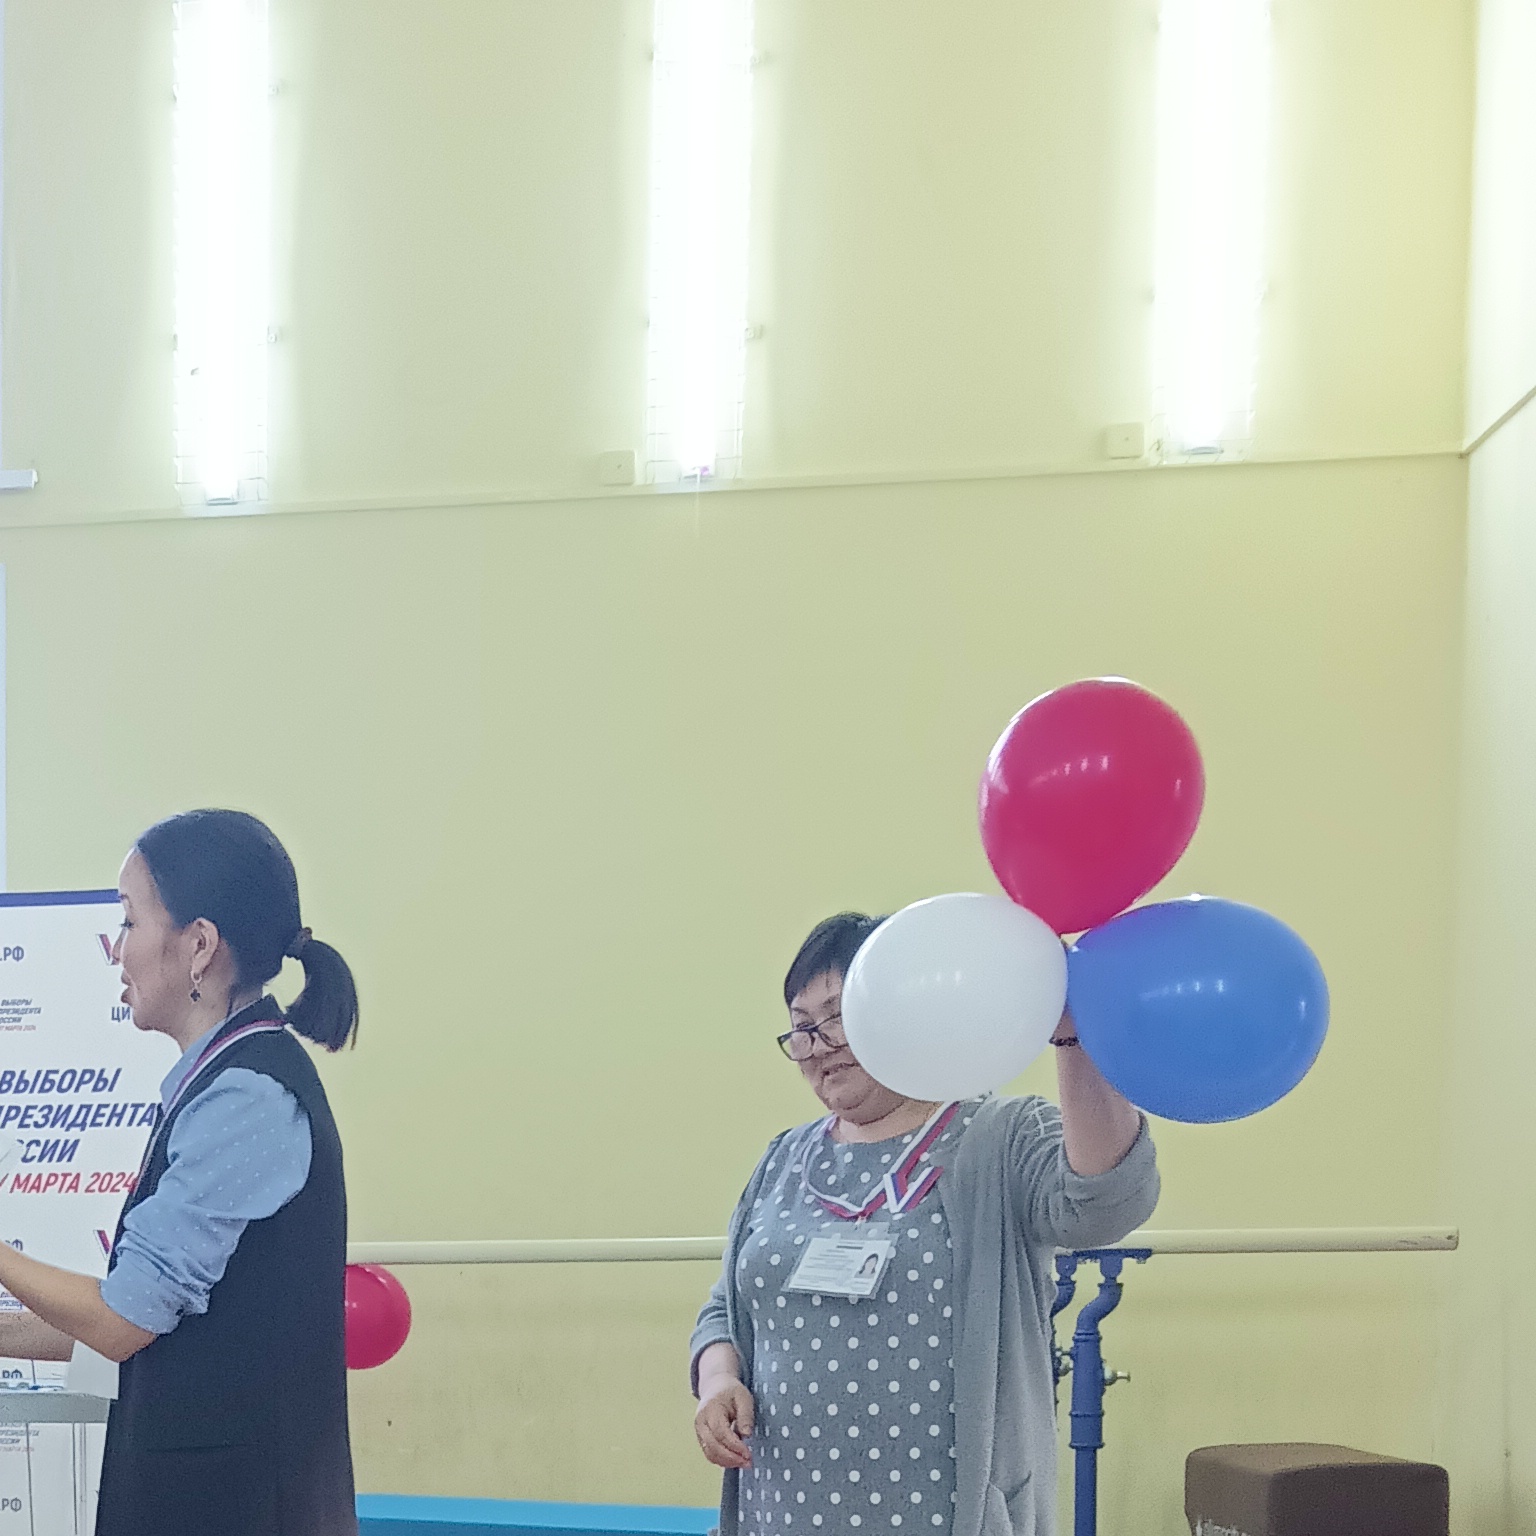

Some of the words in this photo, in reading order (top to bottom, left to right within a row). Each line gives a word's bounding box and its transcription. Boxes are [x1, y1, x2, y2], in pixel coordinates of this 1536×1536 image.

[16, 1138, 81, 1164] СИИ
[9, 1172, 80, 1195] МАРТА
[84, 1171, 138, 1194] 2024
